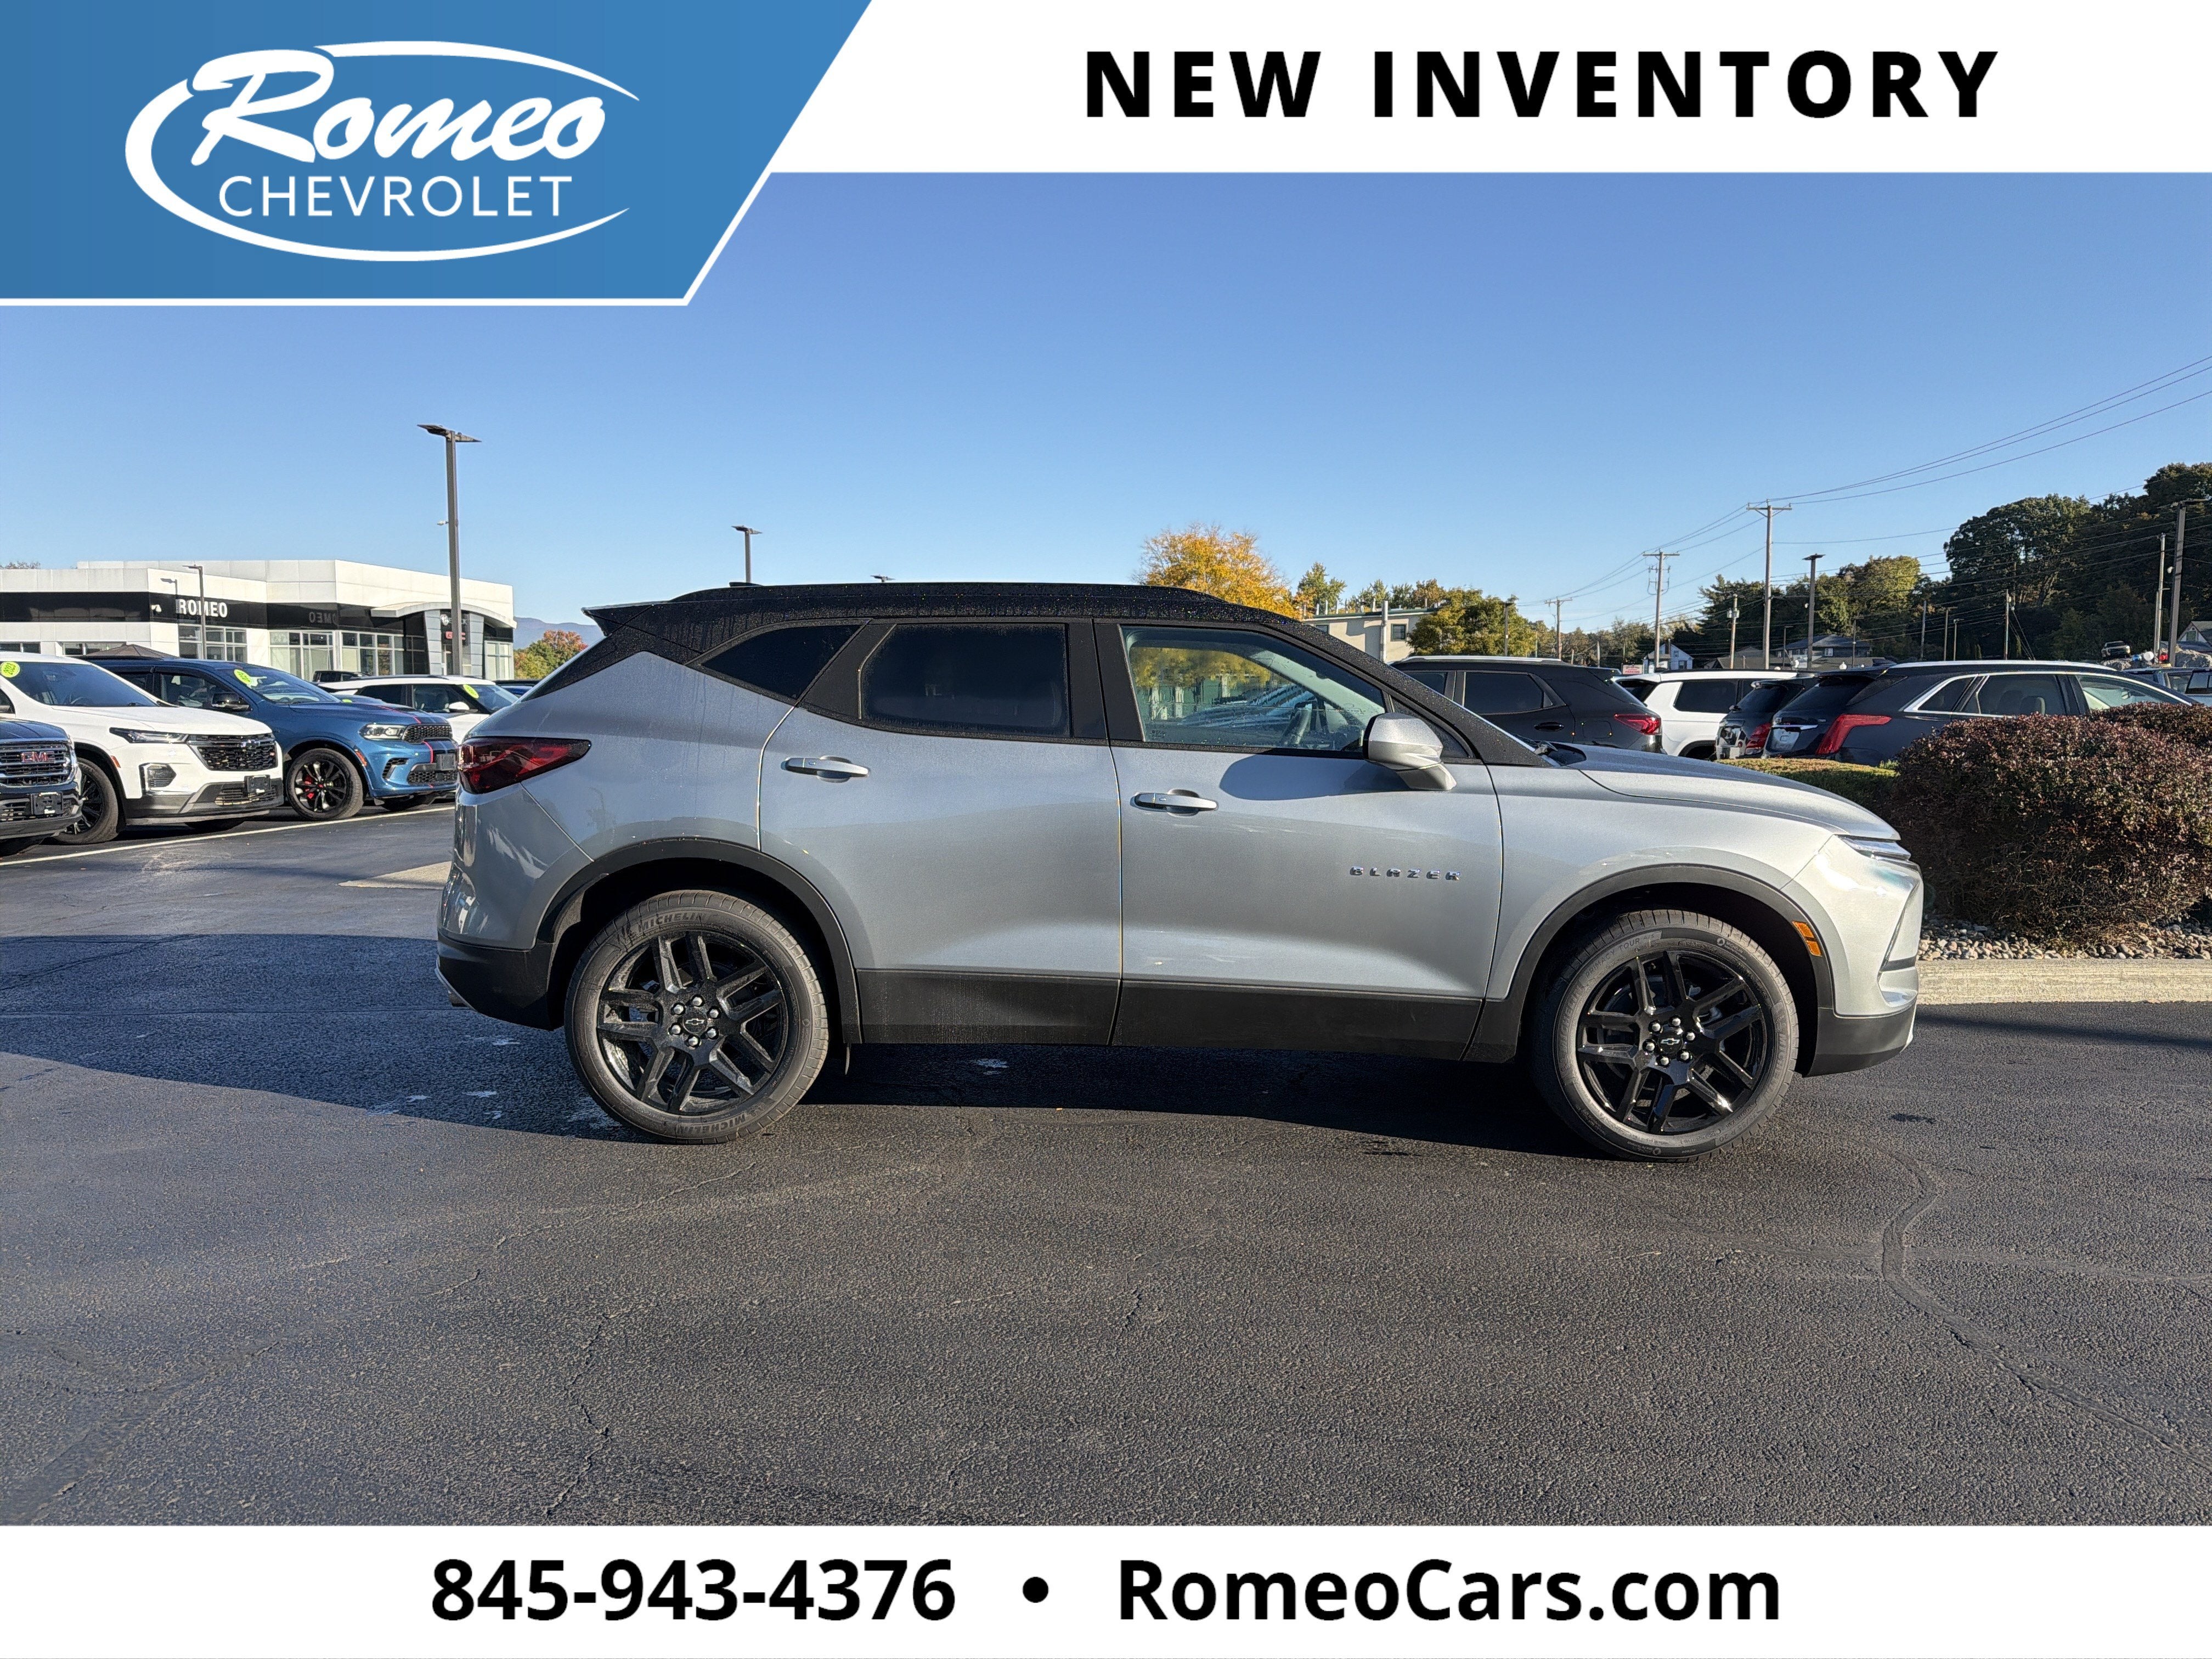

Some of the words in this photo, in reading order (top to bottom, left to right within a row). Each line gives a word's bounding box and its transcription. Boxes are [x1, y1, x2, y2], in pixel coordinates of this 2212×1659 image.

[176, 599, 228, 618] ROMEO
[21, 751, 55, 763] GMC
[1350, 865, 1460, 881] BLAZER
[1620, 938, 1640, 951] TOUR
